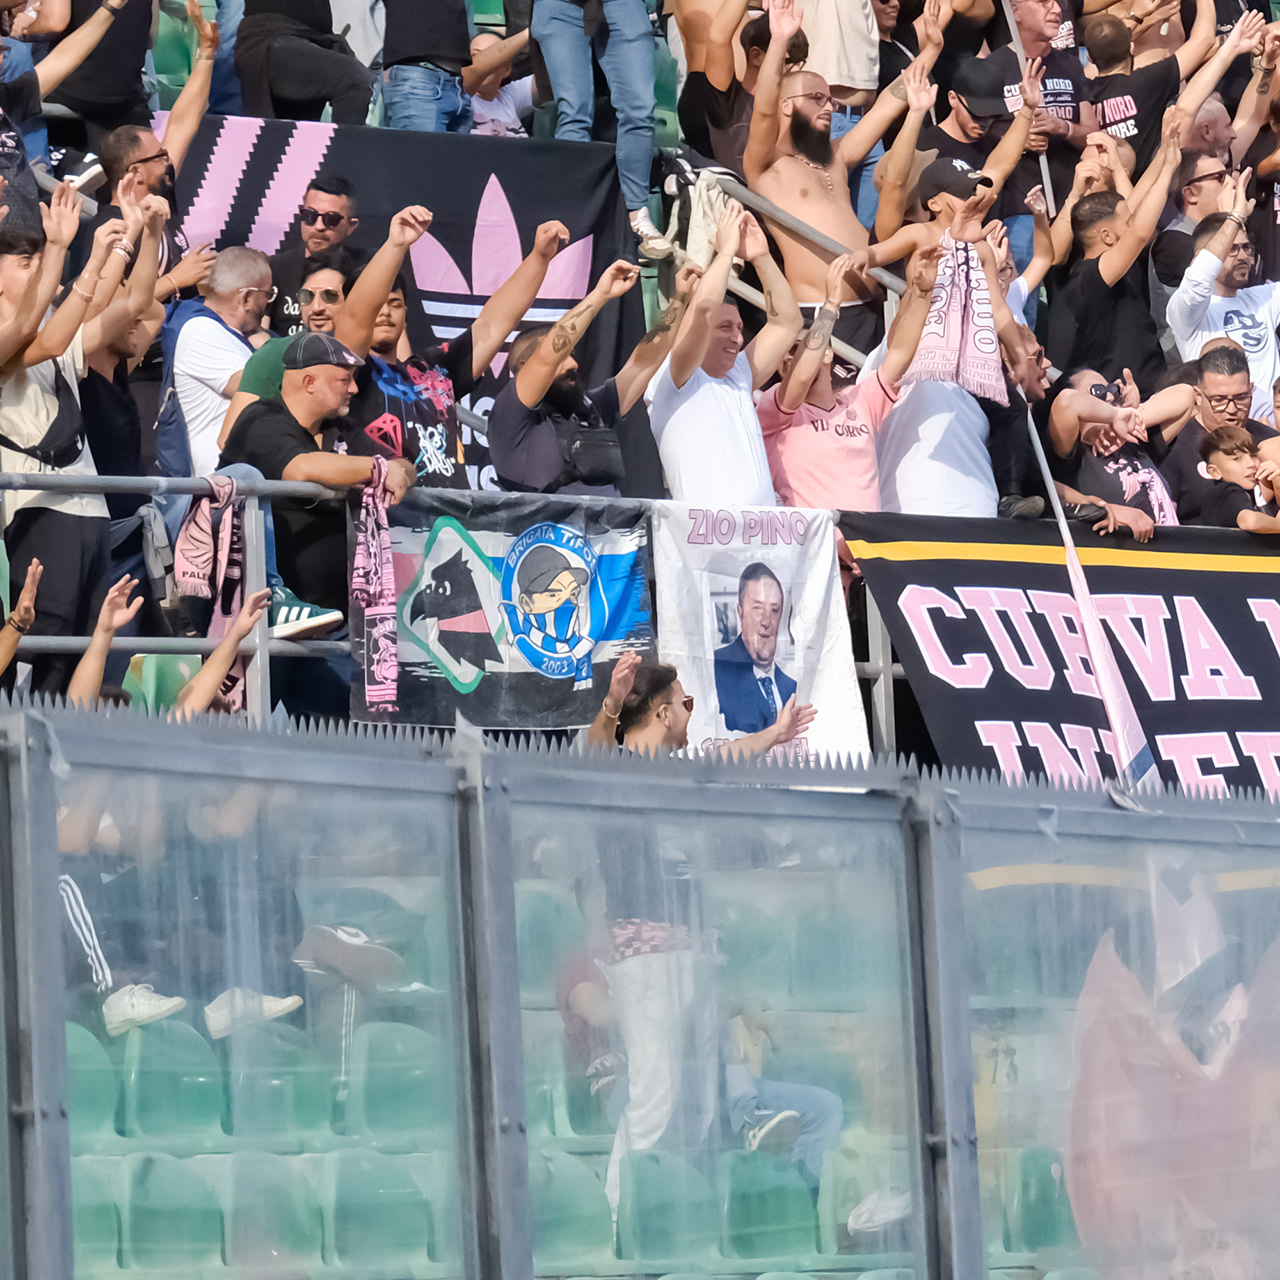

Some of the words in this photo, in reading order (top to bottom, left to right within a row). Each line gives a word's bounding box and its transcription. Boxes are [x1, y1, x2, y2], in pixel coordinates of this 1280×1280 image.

[1044, 78, 1074, 91] NORD
[1103, 94, 1138, 124] NORD
[686, 508, 731, 546] ZIO
[741, 510, 809, 547] PINO
[506, 526, 556, 570] BRIGATA
[898, 583, 1258, 703] CURVA
[540, 656, 568, 674] 2003
